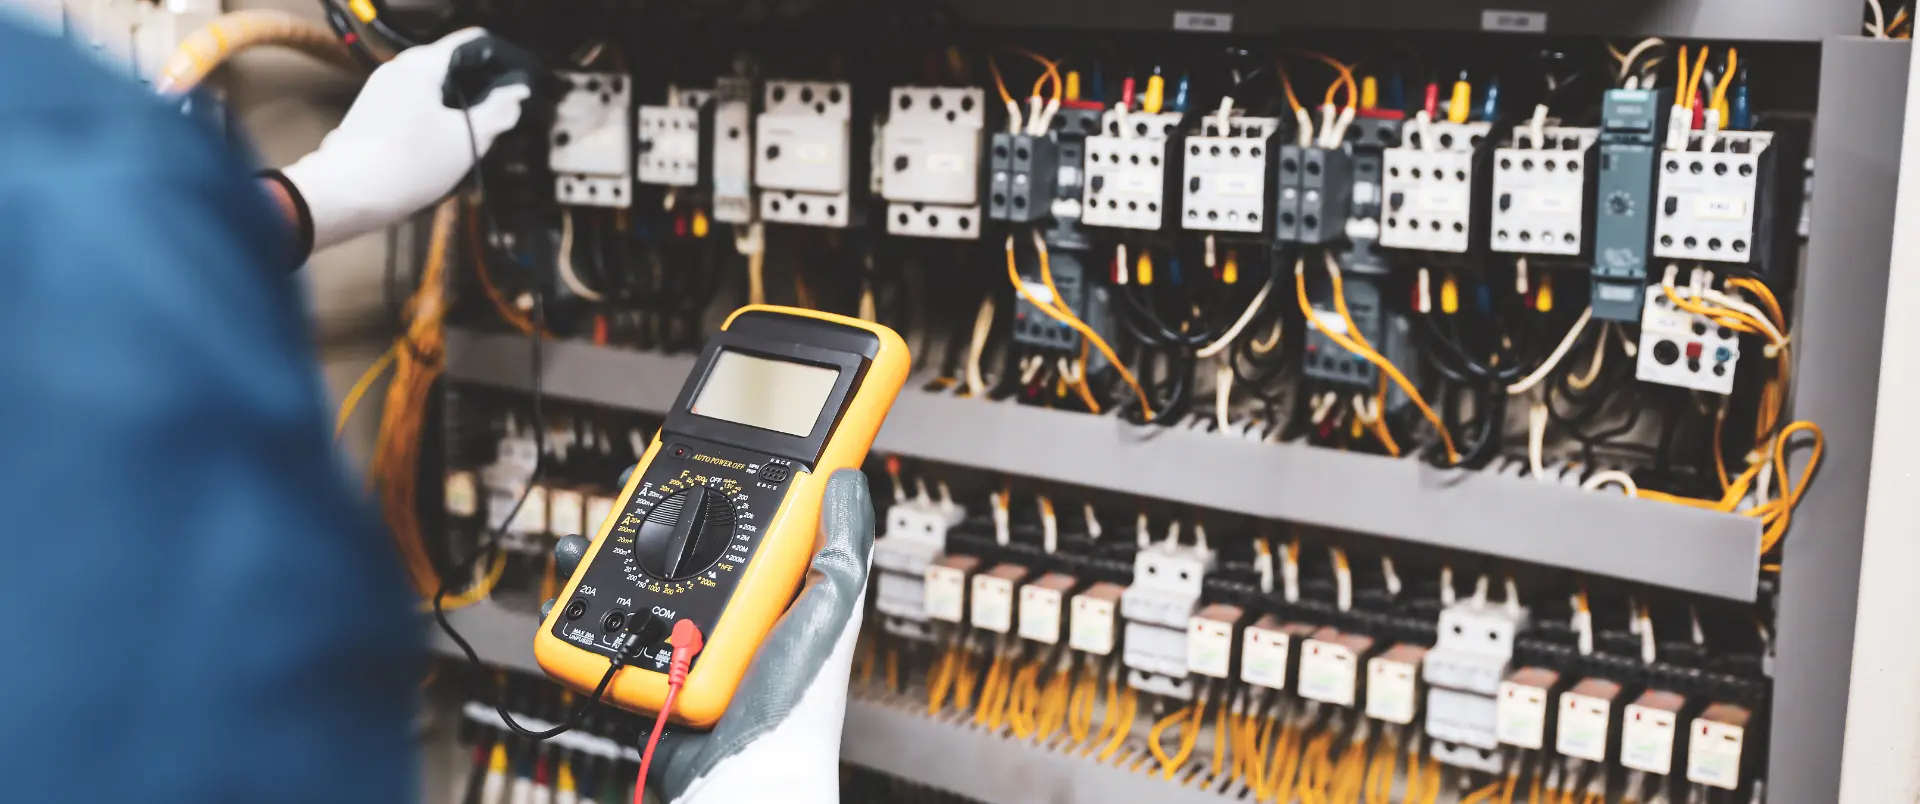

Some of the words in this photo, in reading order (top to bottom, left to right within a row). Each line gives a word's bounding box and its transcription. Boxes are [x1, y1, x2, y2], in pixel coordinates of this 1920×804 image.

[692, 453, 711, 463] AUTO
[710, 457, 732, 468] POWER
[731, 462, 746, 470] OFF
[680, 469, 690, 479] F
[736, 493, 749, 501] 200
[623, 565, 632, 573] 20
[720, 563, 733, 572] hFE
[626, 573, 638, 581] 200
[635, 581, 647, 589] 750
[700, 577, 716, 588] 200m
[579, 584, 597, 597] 20A
[647, 583, 661, 593] 1000
[662, 587, 675, 595] 200
[616, 596, 632, 607] mA
[651, 605, 676, 620] COM
[572, 627, 585, 636] MAX
[568, 633, 593, 646] UNFUSED
